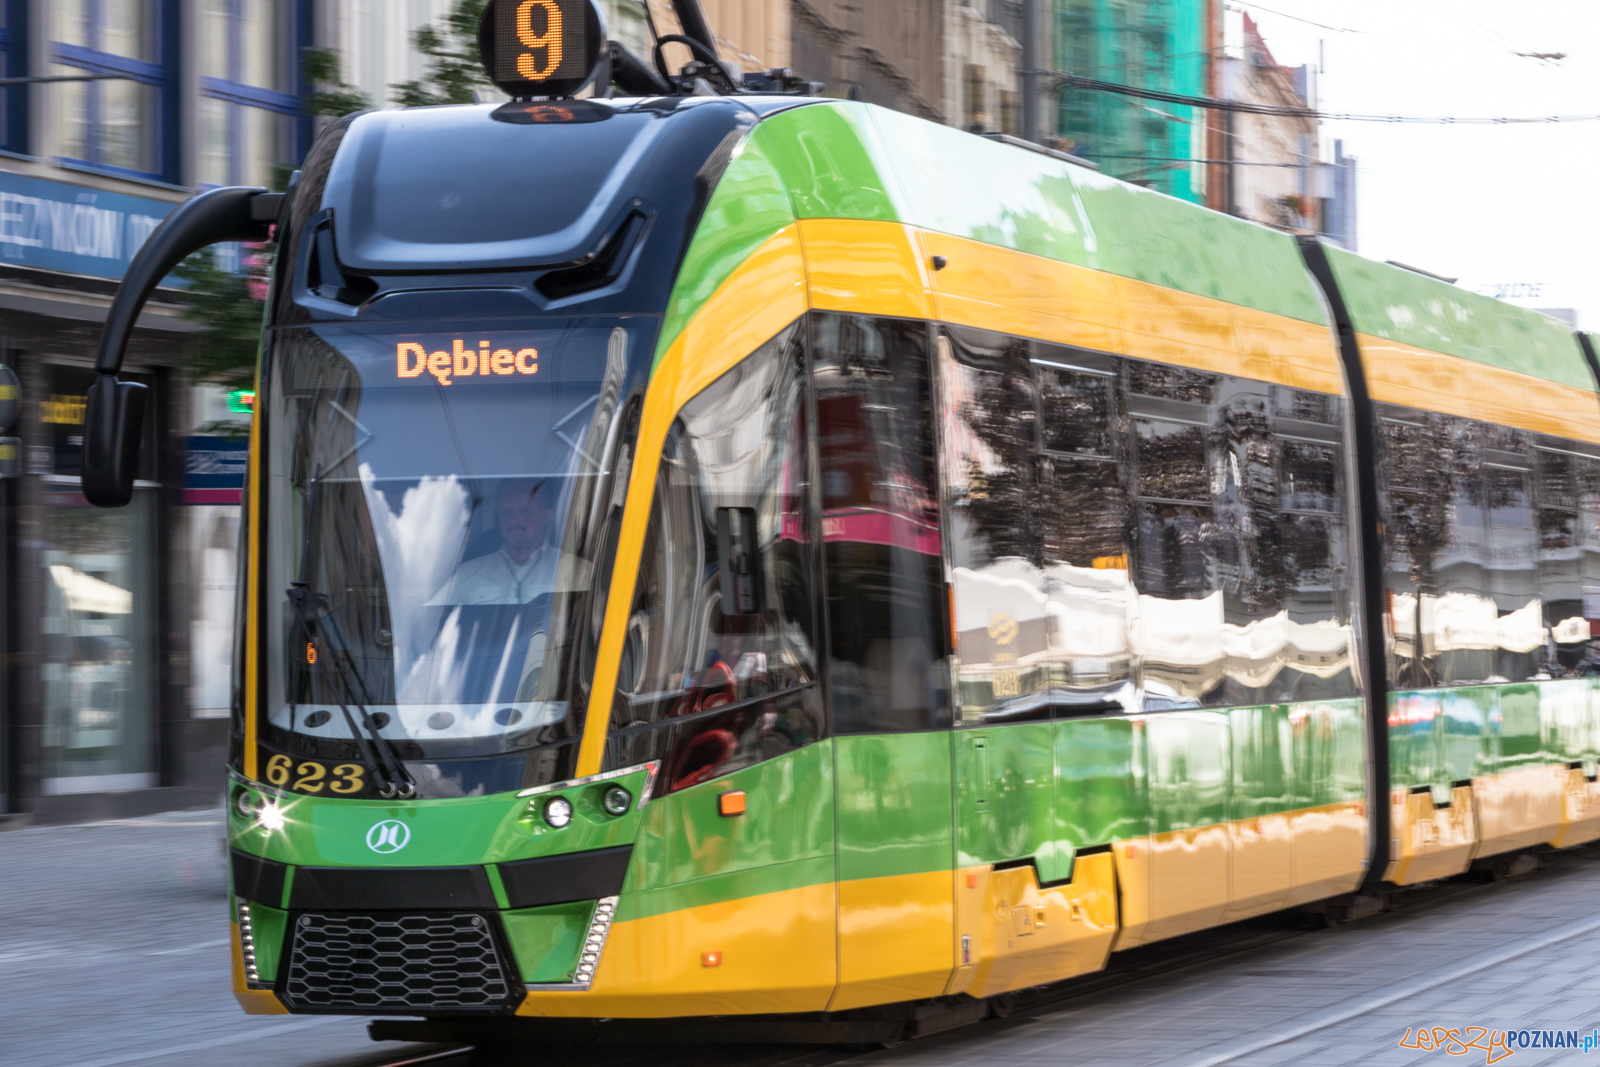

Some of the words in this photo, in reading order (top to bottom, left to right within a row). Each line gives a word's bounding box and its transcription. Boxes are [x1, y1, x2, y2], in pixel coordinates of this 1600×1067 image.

[516, 0, 563, 80] 9
[397, 339, 538, 386] Dębiec
[265, 753, 365, 794] 623
